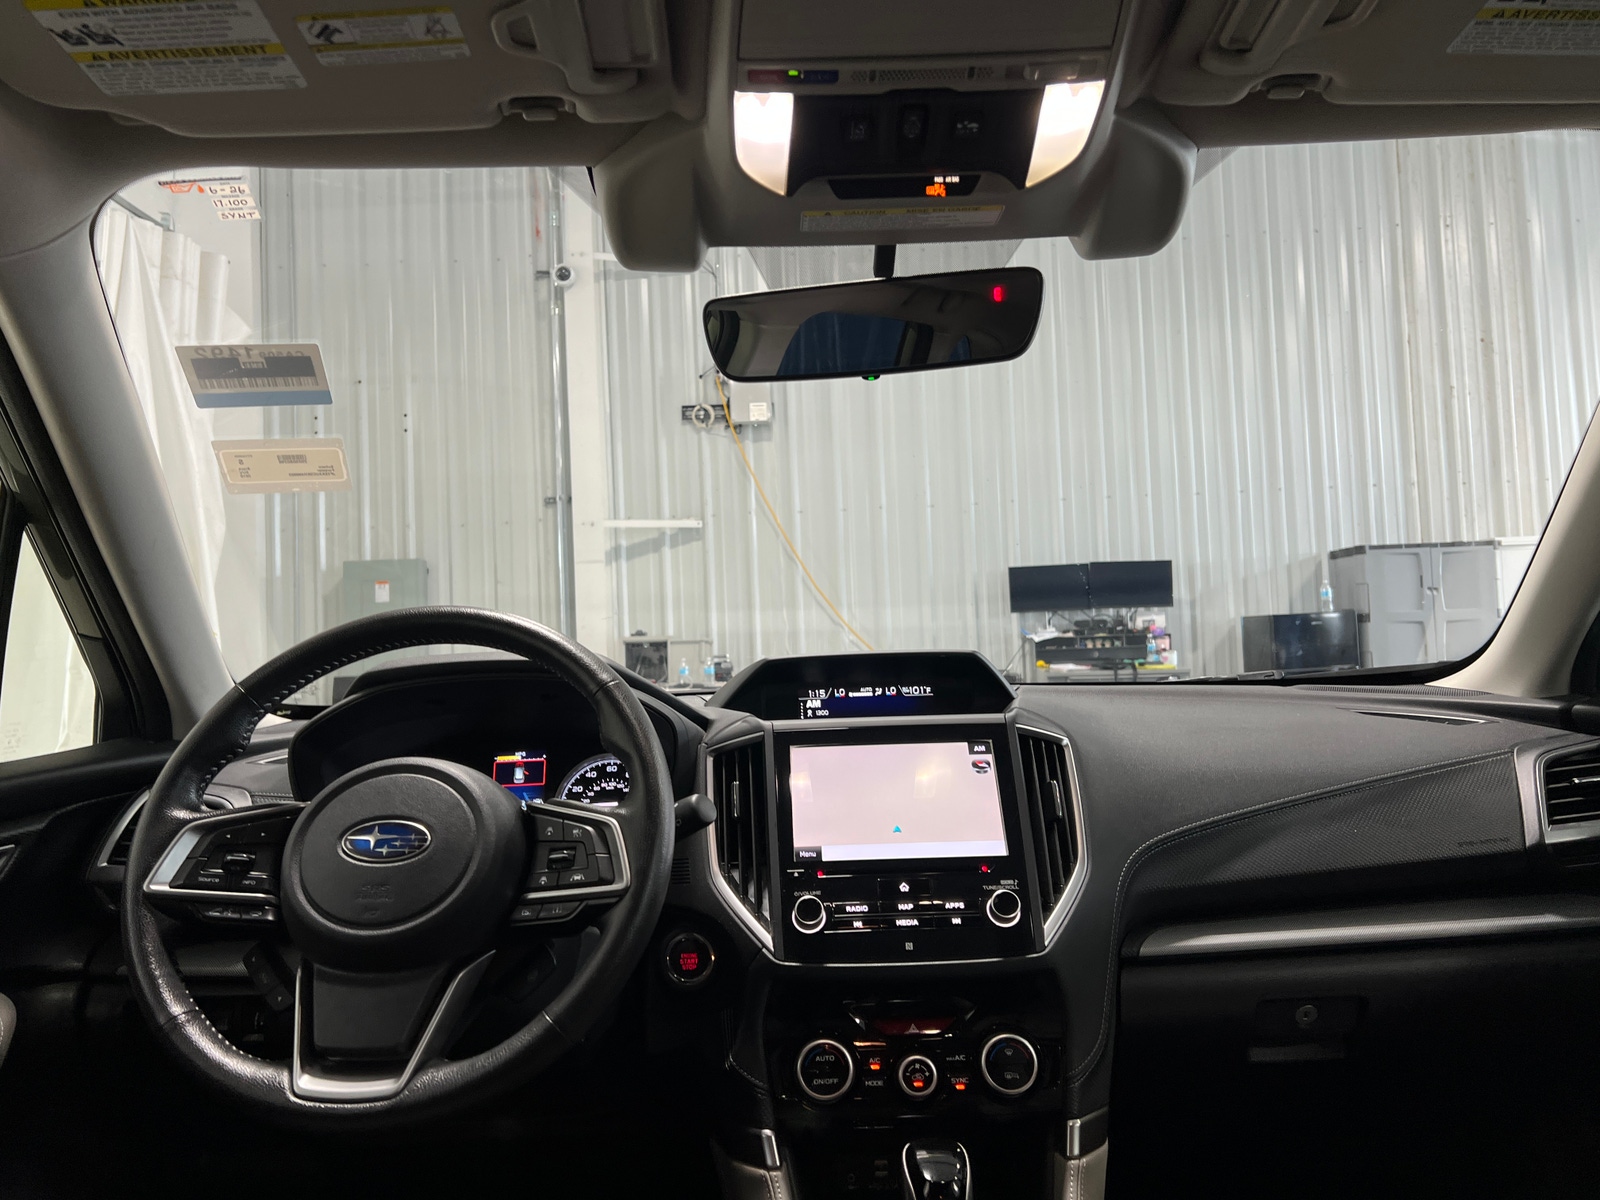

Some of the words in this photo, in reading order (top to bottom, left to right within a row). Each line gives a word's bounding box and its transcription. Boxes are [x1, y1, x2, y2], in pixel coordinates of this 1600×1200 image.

[108, 44, 267, 61] AVERTISSEMENT
[808, 689, 826, 699] 1:15
[805, 700, 822, 709] AM
[606, 765, 618, 773] 60
[571, 785, 584, 793] 20
[799, 850, 817, 858] Menu
[845, 904, 869, 912] RADIO
[897, 903, 914, 911] MAP
[945, 901, 965, 909] APPS
[895, 919, 919, 927] MEDIA
